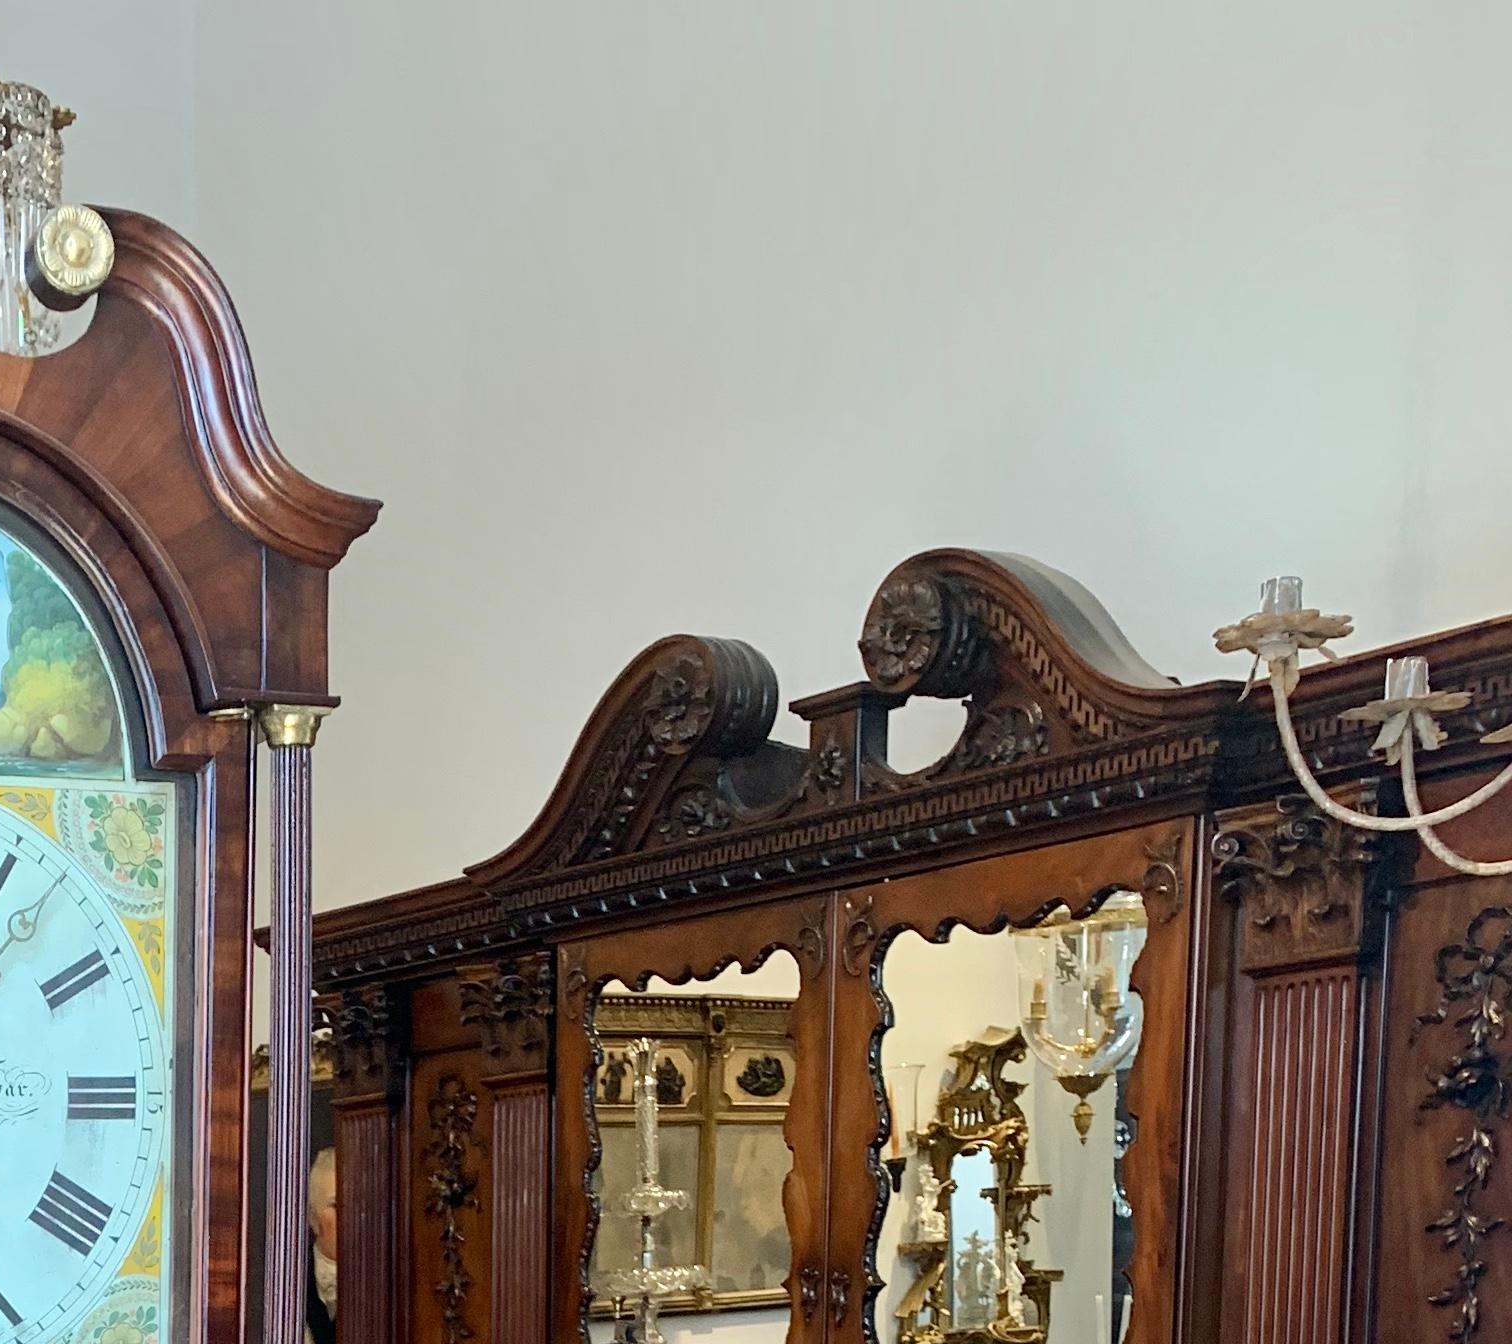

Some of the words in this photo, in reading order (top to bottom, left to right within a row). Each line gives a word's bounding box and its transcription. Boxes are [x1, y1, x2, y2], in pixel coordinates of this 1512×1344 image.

[35, 942, 114, 1018] II
[67, 1071, 136, 1126] III
[146, 1089, 164, 1114] 15
[25, 1163, 116, 1262] IIII
